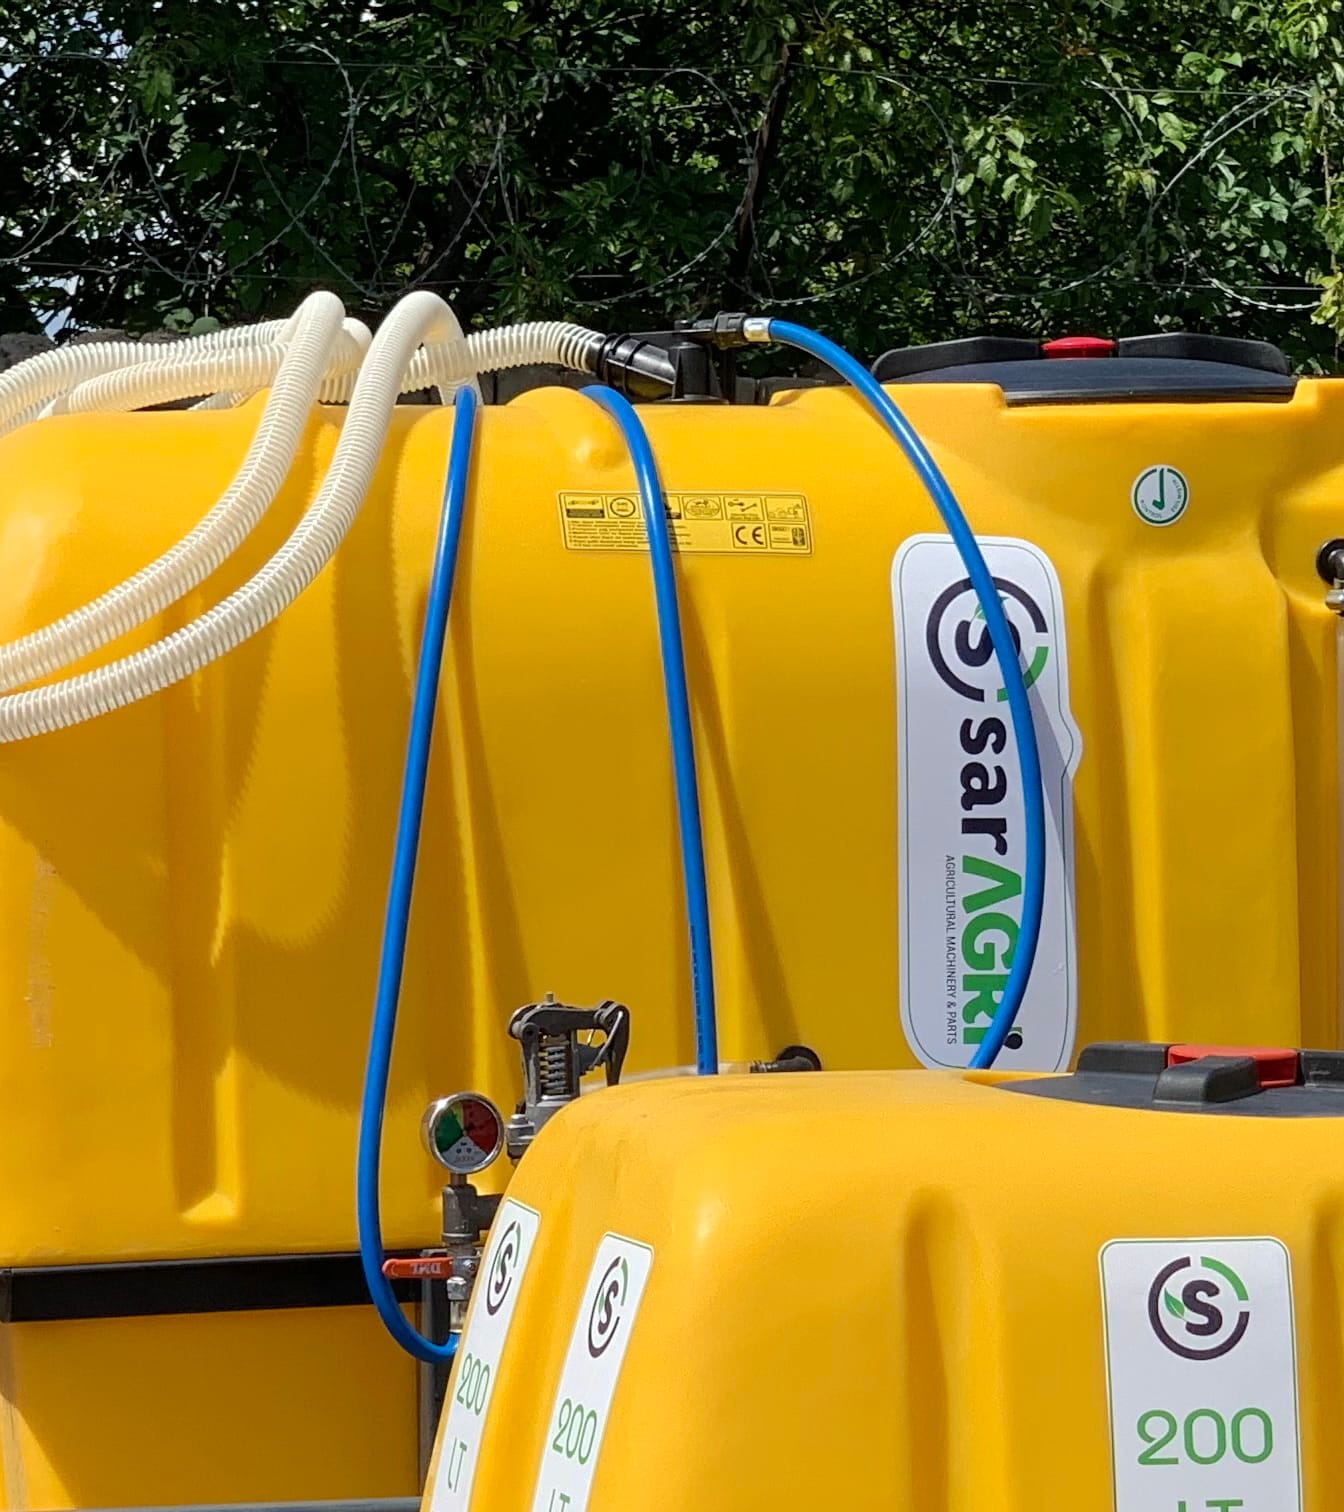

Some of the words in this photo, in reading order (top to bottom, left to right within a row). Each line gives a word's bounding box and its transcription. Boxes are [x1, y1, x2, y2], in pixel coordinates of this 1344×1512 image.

[735, 525, 764, 545] CE
[946, 855, 957, 932] AGRICULTURAL
[946, 936, 957, 997] MACHINERY
[947, 1001, 957, 1009] &
[947, 1011, 958, 1045] PARTS
[456, 1353, 490, 1416] 200
[553, 1398, 597, 1465] 200
[1136, 1407, 1274, 1466] 200
[447, 1436, 468, 1494] LT
